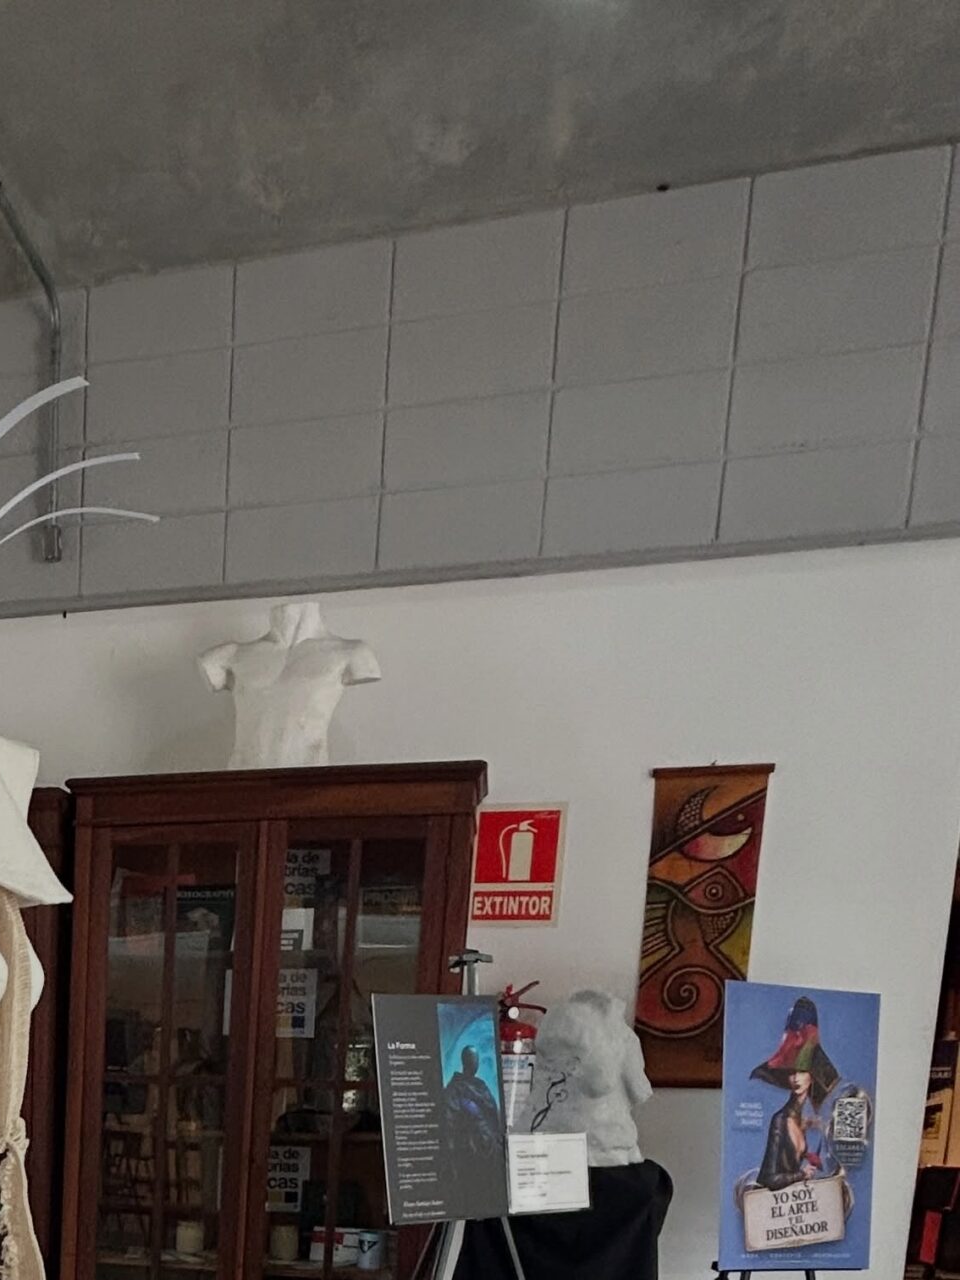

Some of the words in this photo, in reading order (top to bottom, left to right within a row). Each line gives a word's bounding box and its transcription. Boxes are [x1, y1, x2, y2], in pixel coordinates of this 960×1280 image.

[472, 895, 551, 916] EXTINTOR
[773, 1191, 790, 1205] YO
[791, 1188, 814, 1202] SOY
[771, 1206, 786, 1218] EL
[789, 1200, 819, 1217] ARTE
[765, 1220, 830, 1242] DISEÑADOR
